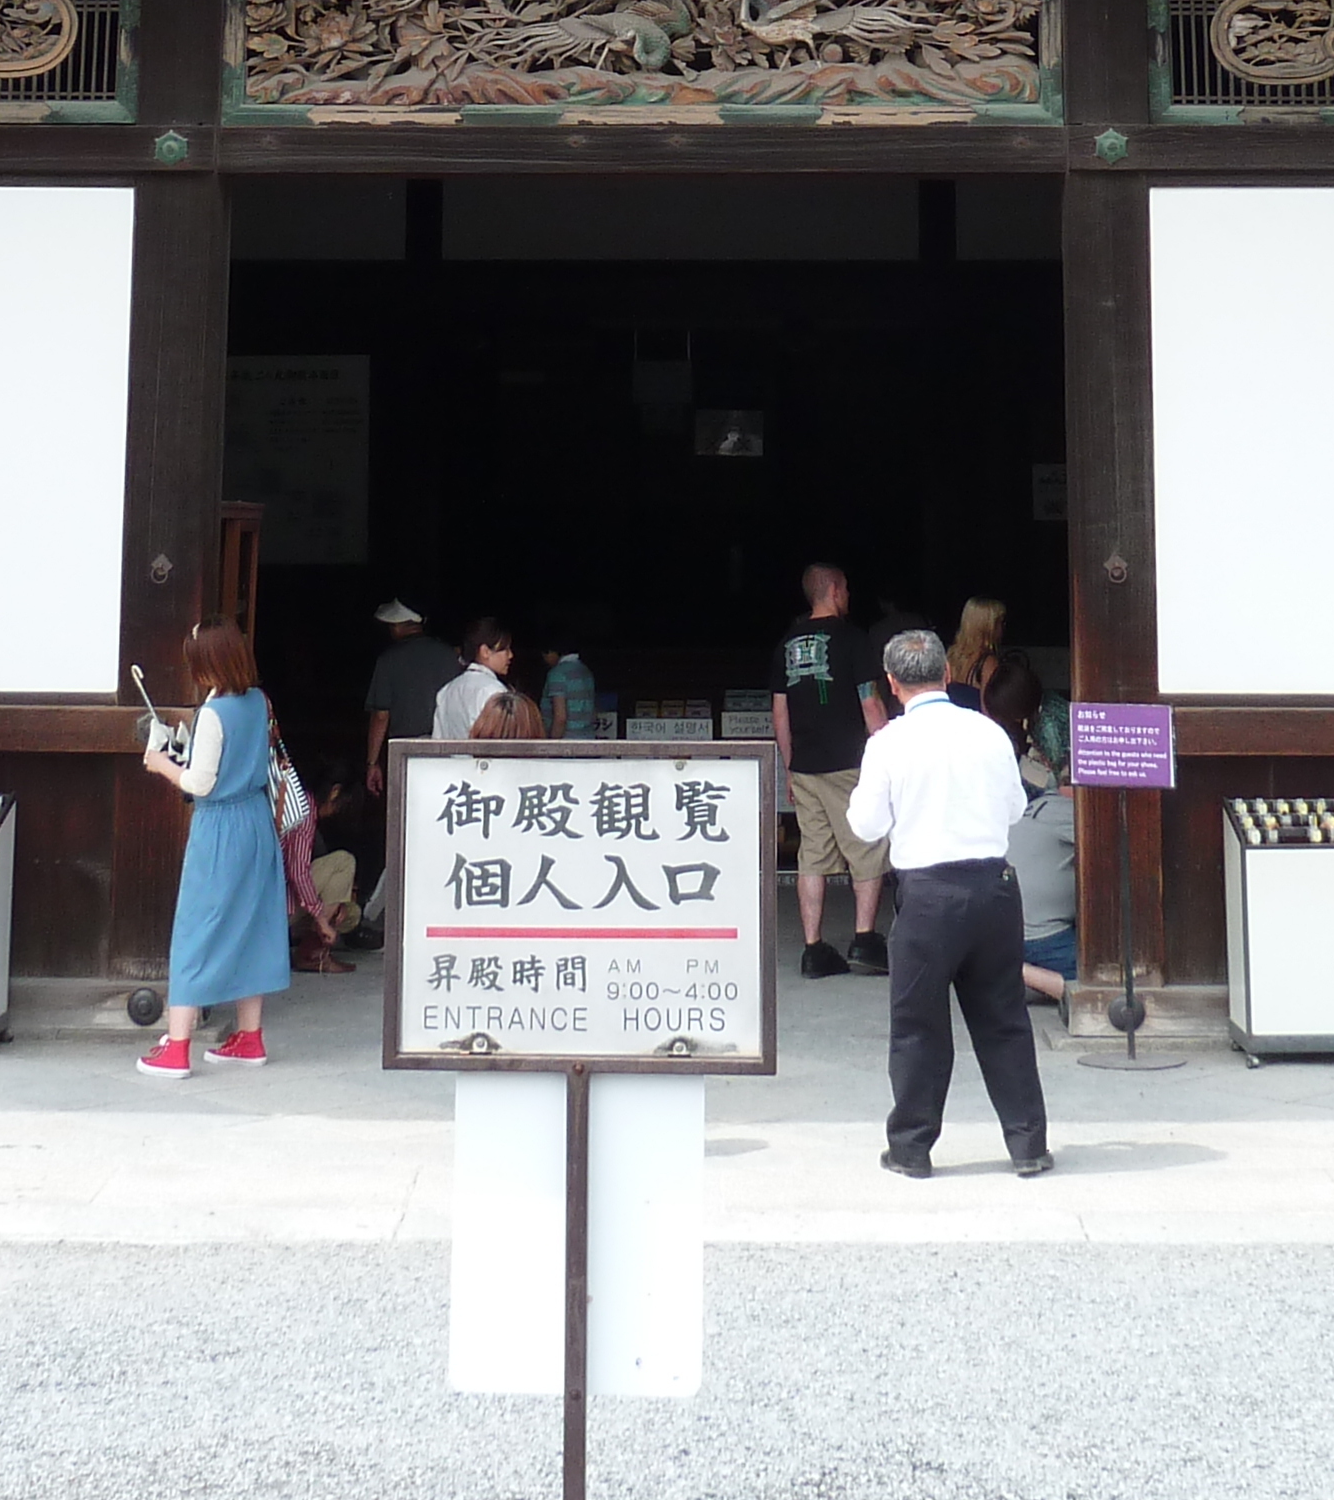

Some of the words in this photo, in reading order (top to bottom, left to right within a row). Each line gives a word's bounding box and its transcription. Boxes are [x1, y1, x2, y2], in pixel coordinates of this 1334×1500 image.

[631, 721, 666, 734] 한국어
[1077, 710, 1106, 720] お知らせ
[436, 780, 731, 842] 御殿観覧
[444, 853, 722, 910] 個人入口
[426, 953, 588, 993] 昇殿時間
[608, 959, 642, 974] AM
[686, 959, 719, 974] PM
[423, 1006, 588, 1031] ENTRANCE
[623, 1008, 726, 1032] HOURS
